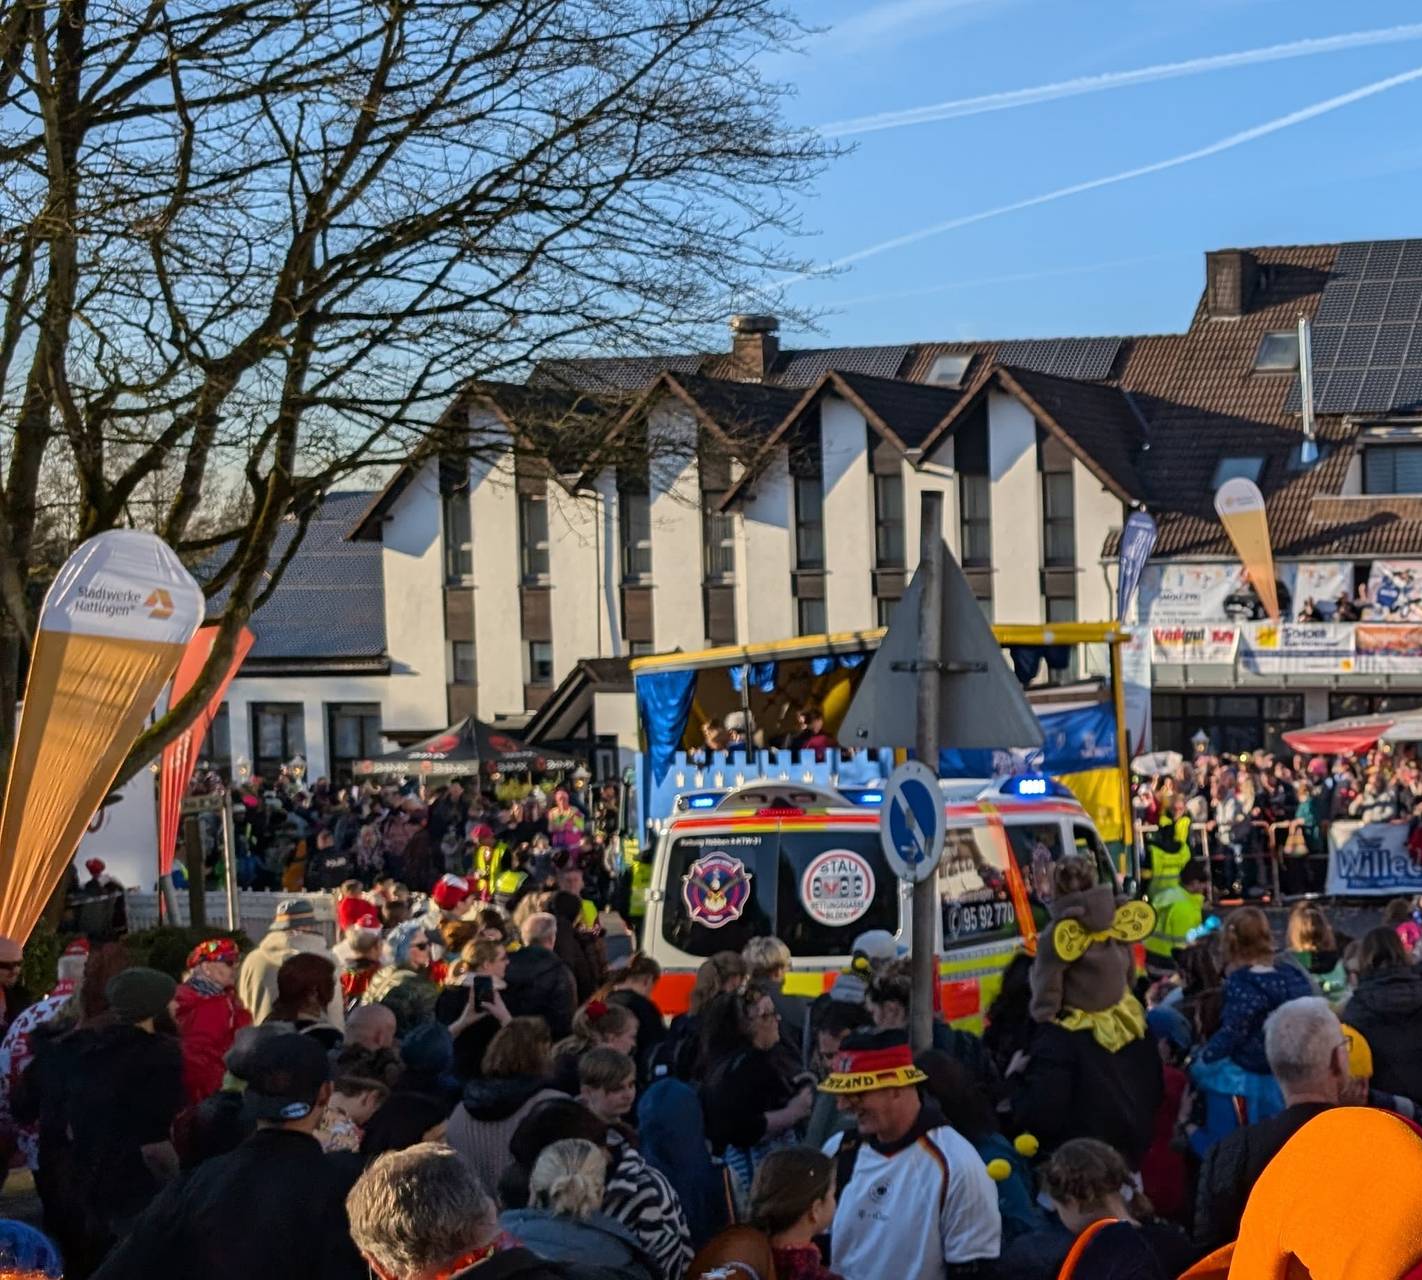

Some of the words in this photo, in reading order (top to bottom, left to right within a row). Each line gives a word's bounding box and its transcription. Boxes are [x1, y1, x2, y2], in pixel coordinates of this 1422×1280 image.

[963, 905, 978, 932] 95
[979, 903, 994, 929] 92
[996, 900, 1015, 925] 770
